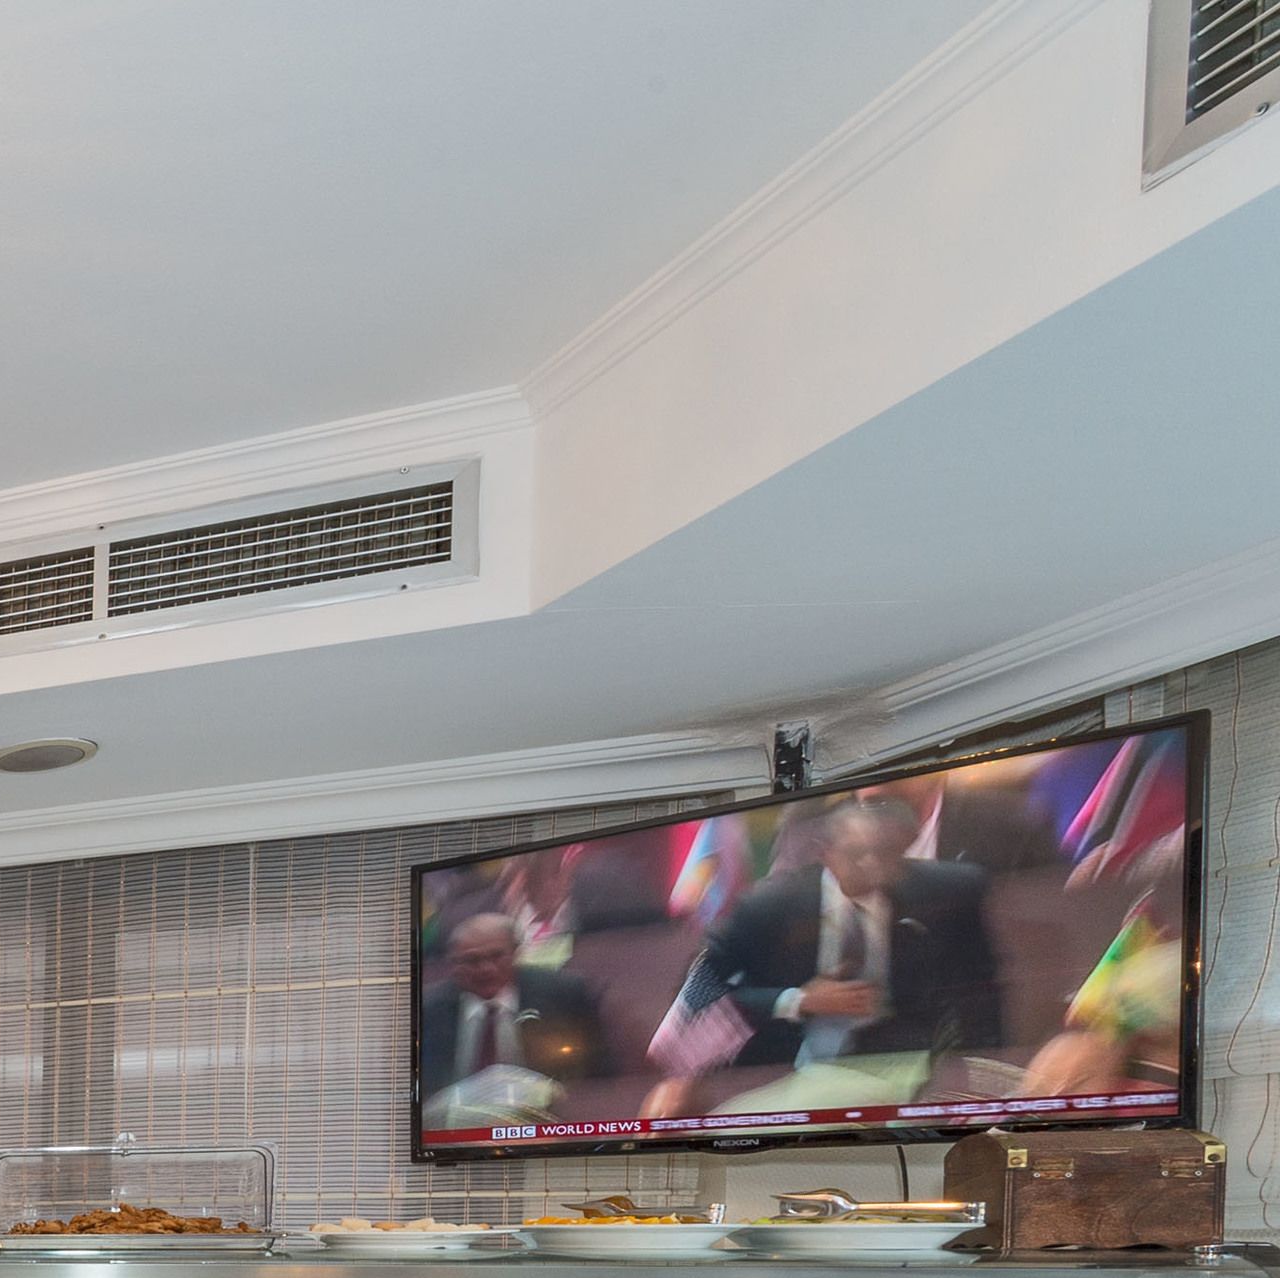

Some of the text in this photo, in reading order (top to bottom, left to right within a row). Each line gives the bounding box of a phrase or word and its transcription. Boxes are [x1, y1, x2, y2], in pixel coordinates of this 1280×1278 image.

[492, 1121, 641, 1140] BBC WORLD NEWS
[713, 1137, 760, 1148] NEXON
